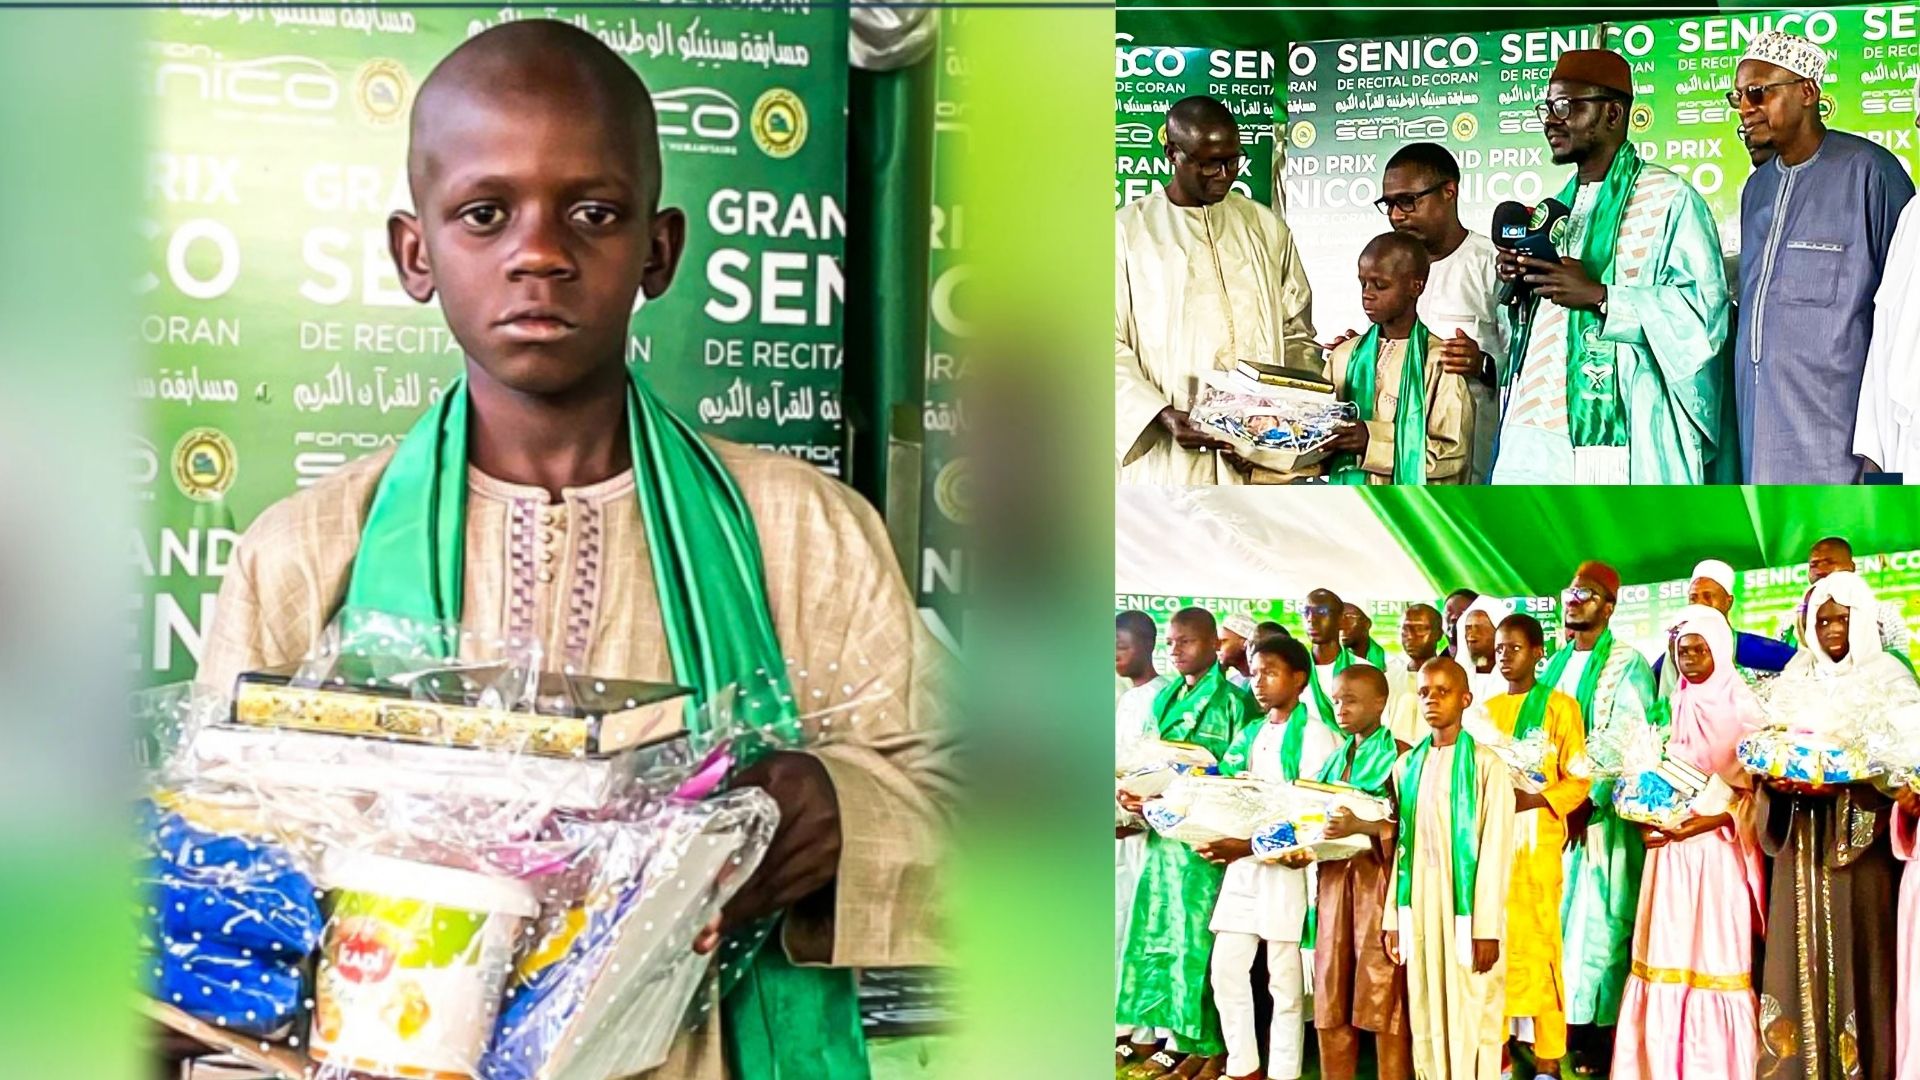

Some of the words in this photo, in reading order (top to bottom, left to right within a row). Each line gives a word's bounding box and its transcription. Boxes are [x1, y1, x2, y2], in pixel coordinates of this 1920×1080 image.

[677, 15, 739, 69] سينيكو
[741, 31, 810, 69] مسابقة
[1863, 46, 1884, 60] DE
[1337, 36, 1479, 74] SENICO
[1678, 58, 1698, 72] DE
[1337, 78, 1354, 91] DE
[1357, 75, 1409, 90] RECITAL
[1412, 74, 1429, 87] DE
[1431, 72, 1479, 86] CORAN
[1501, 69, 1519, 82] DE
[1117, 82, 1133, 93] DE
[1136, 82, 1186, 94] CORAN
[1209, 83, 1228, 95] DE
[1489, 146, 1543, 168] PRIX
[1666, 137, 1724, 160] PRIX
[1326, 153, 1377, 175] PRIX
[300, 322, 342, 351] DE
[704, 340, 744, 367] DE
